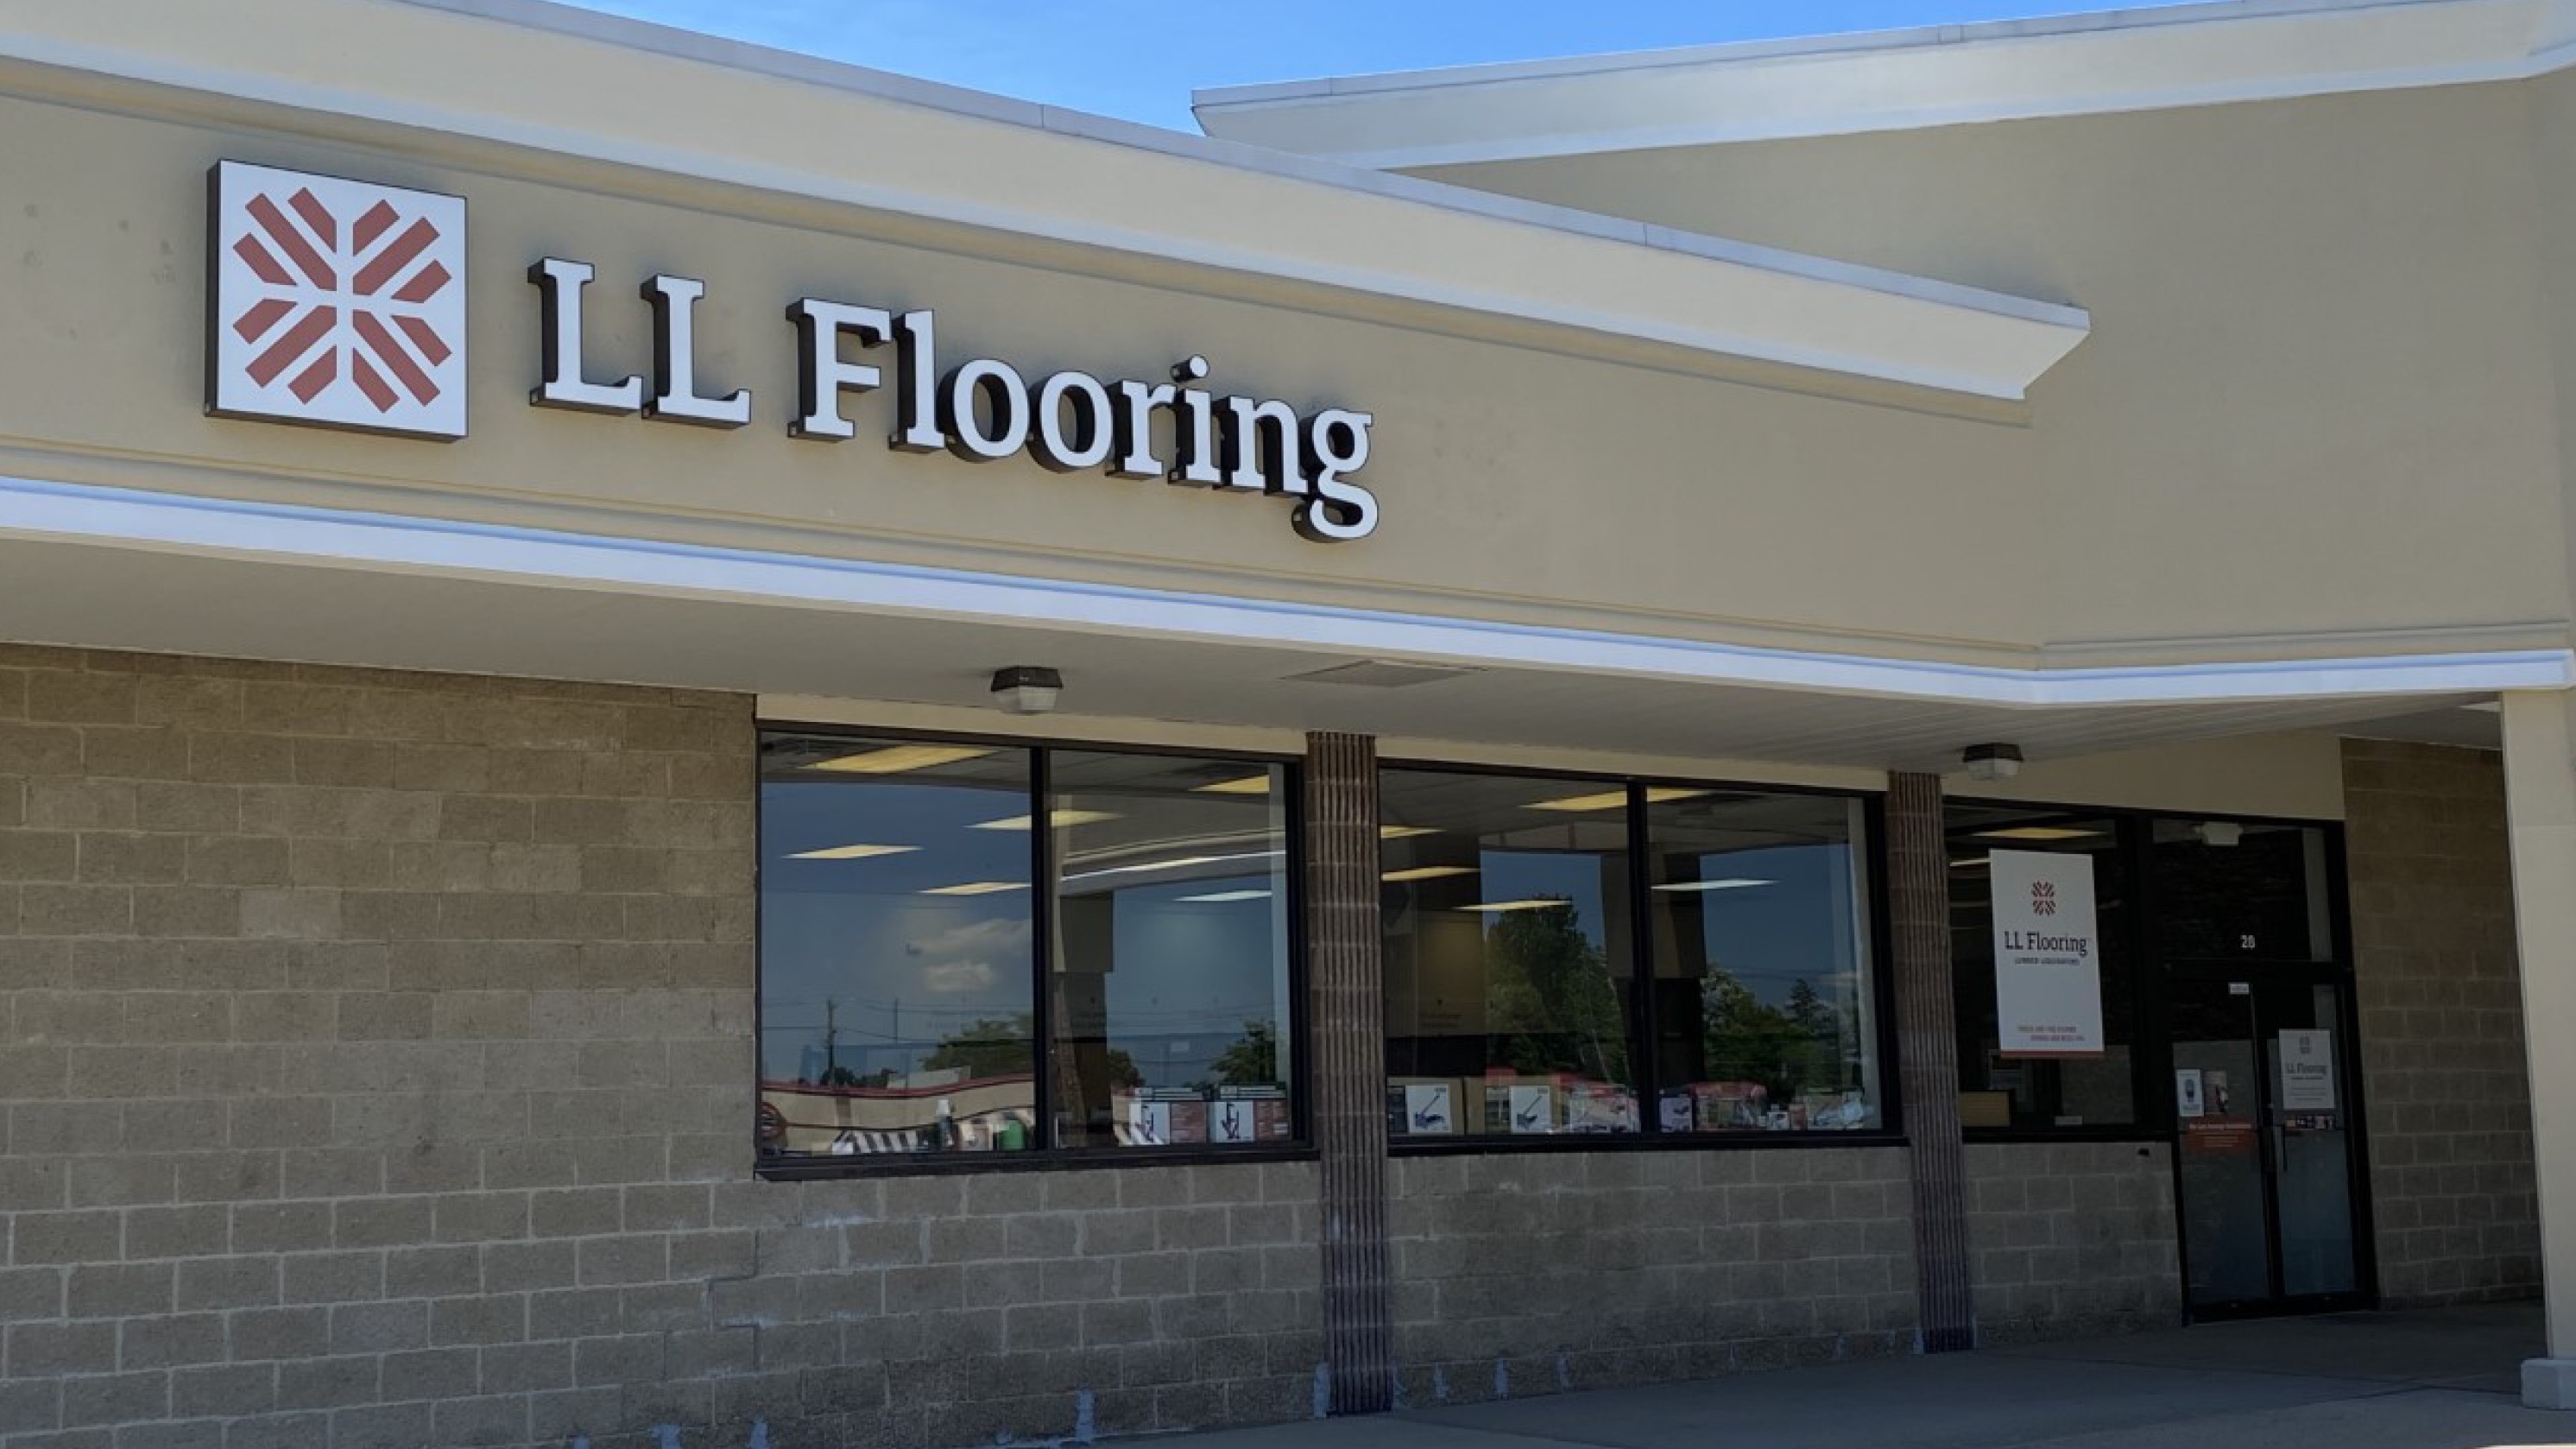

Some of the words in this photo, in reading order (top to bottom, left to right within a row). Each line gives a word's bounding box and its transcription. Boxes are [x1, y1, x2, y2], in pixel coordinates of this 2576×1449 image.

[541, 257, 752, 427] LL
[801, 297, 1380, 539] Flooring
[2004, 931, 2024, 950] LL
[2026, 931, 2088, 958] Flooring
